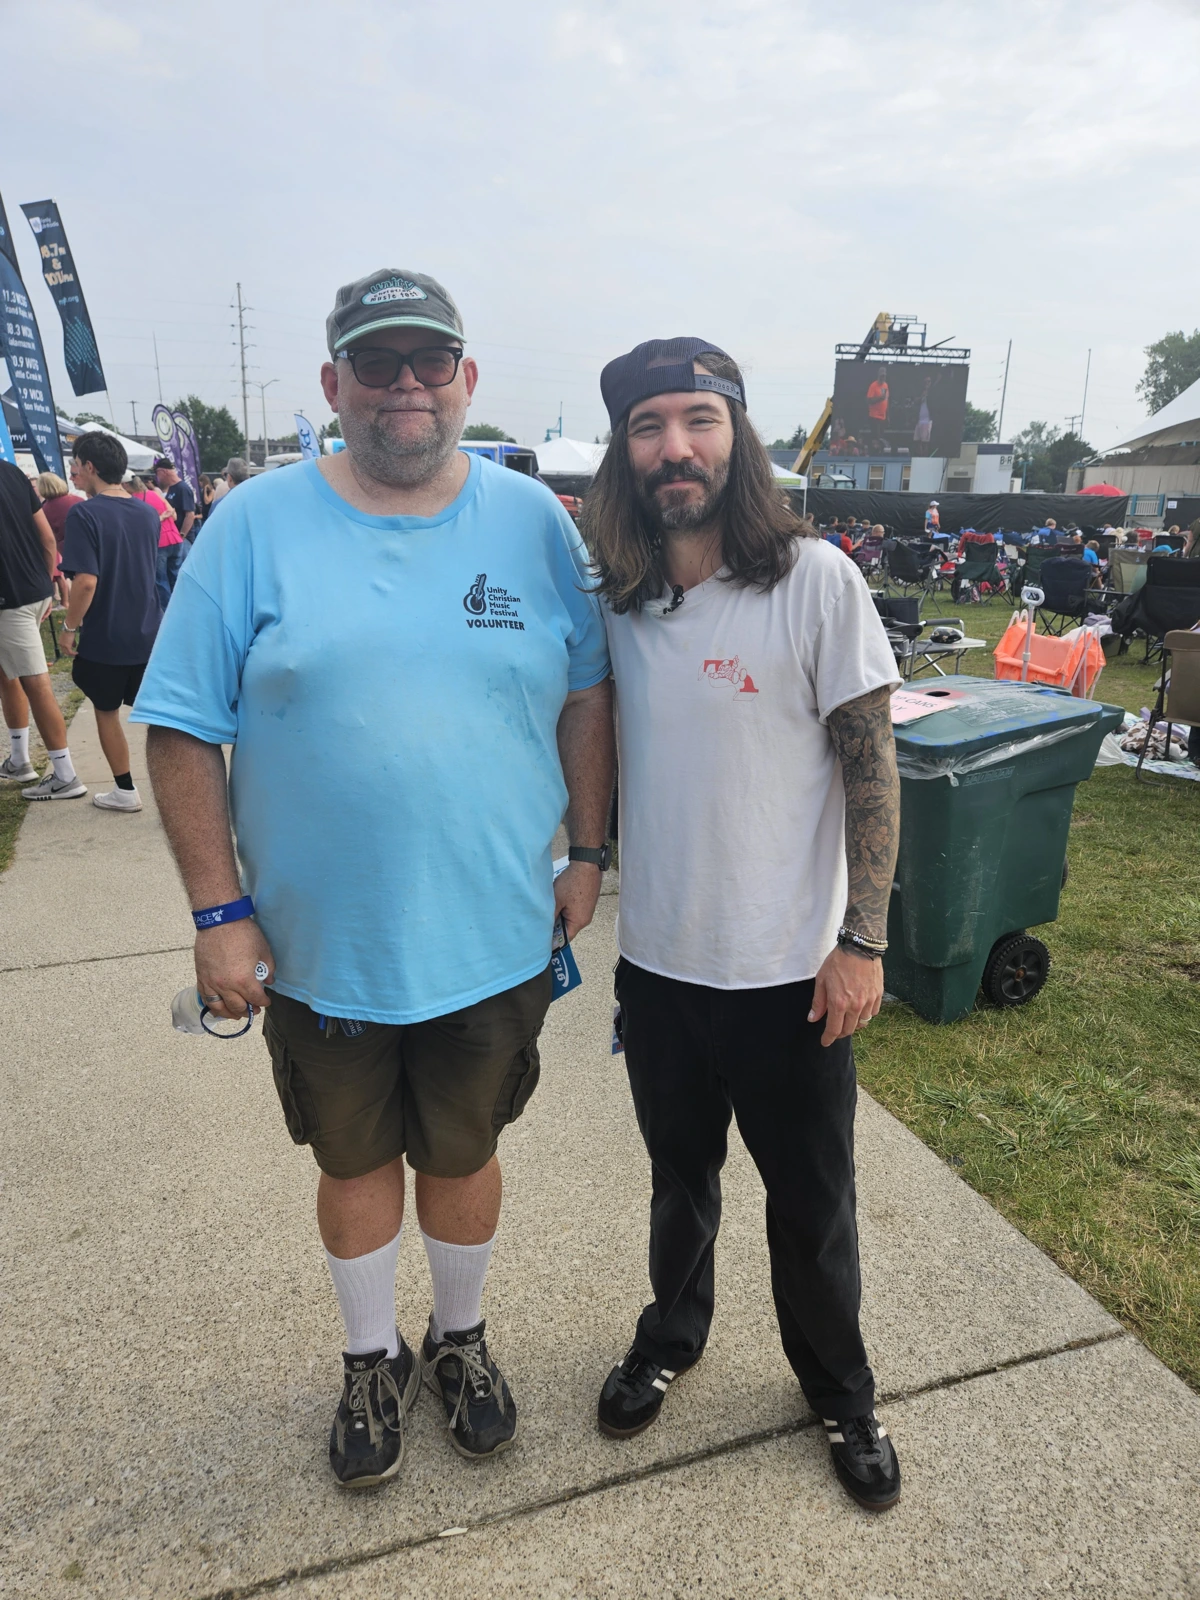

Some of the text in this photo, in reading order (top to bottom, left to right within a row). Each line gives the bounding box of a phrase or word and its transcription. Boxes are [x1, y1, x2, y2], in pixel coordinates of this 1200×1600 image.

[52, 258, 62, 270] &
[370, 277, 414, 293] unity
[486, 586, 508, 596] Unity
[488, 594, 521, 603] Christian
[489, 601, 511, 610] Music
[490, 608, 519, 618] Festival
[466, 618, 525, 631] VOLUNTEER
[551, 956, 566, 982] 91.3
